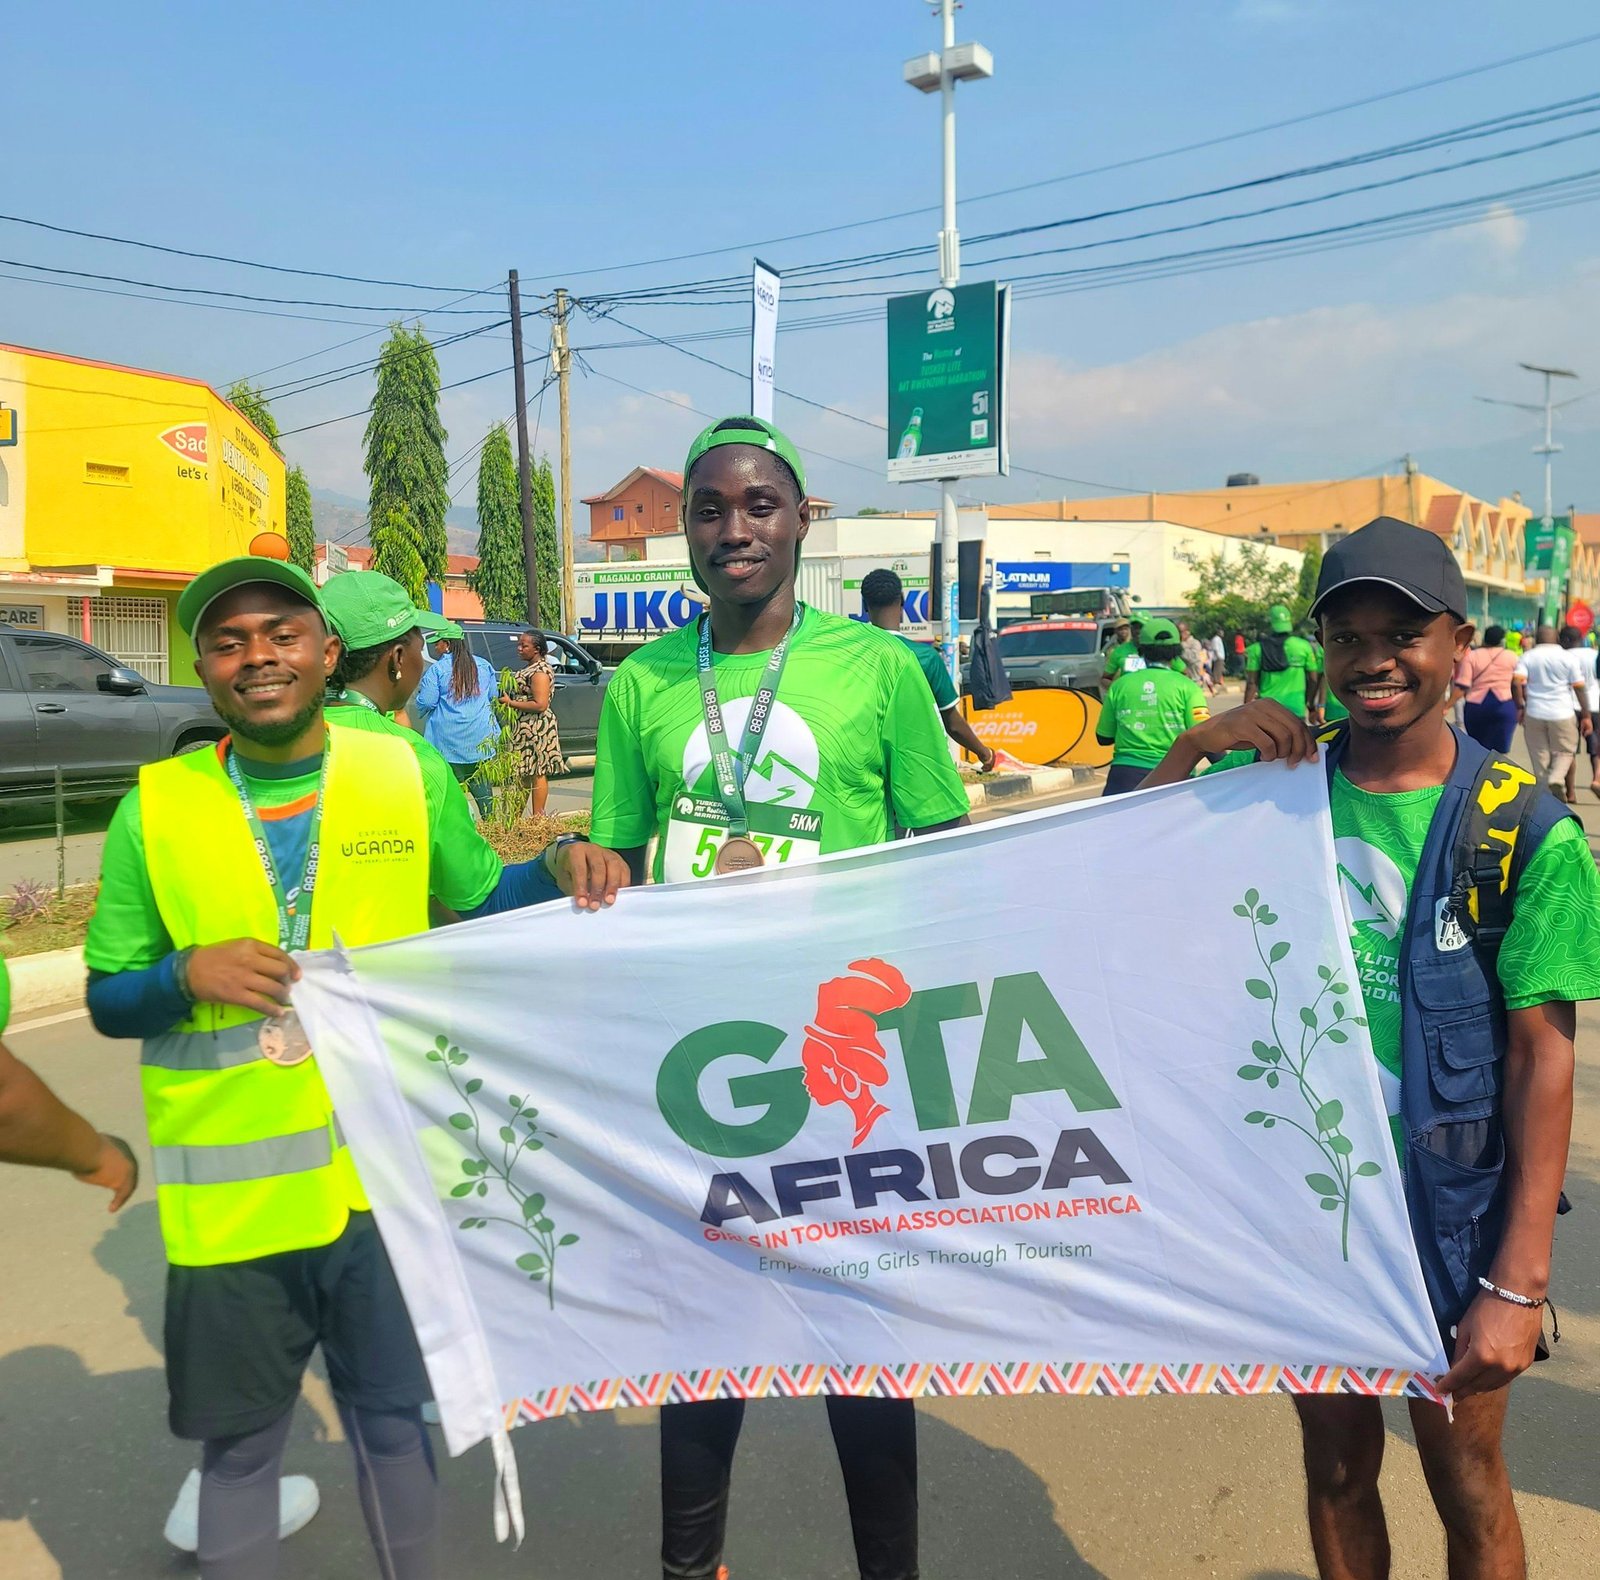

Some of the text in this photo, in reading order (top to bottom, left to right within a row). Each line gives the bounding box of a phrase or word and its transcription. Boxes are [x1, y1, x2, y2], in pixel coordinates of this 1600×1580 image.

[177, 466, 201, 480] let's
[599, 573, 642, 583] MAGANJO
[644, 571, 672, 581] GRAIN
[0, 610, 38, 624] CARE
[580, 590, 703, 630] JIKO
[970, 721, 1037, 736] GANDA
[695, 799, 723, 808] TUSKER
[694, 812, 730, 821] MARATHO
[789, 813, 819, 833] 5KM
[358, 829, 399, 837] EXPLORE
[341, 839, 415, 857] UGANDA
[692, 828, 794, 877] 571
[700, 1127, 1133, 1228] AFRICA
[765, 1230, 788, 1249] IN
[790, 1216, 891, 1245] TOURISM
[896, 1202, 1051, 1232] ASSOCIATION
[1055, 1194, 1142, 1218] AFRICA
[877, 1251, 920, 1271] Girls
[927, 1244, 1007, 1267] Through
[1015, 1241, 1092, 1259] Tourism
